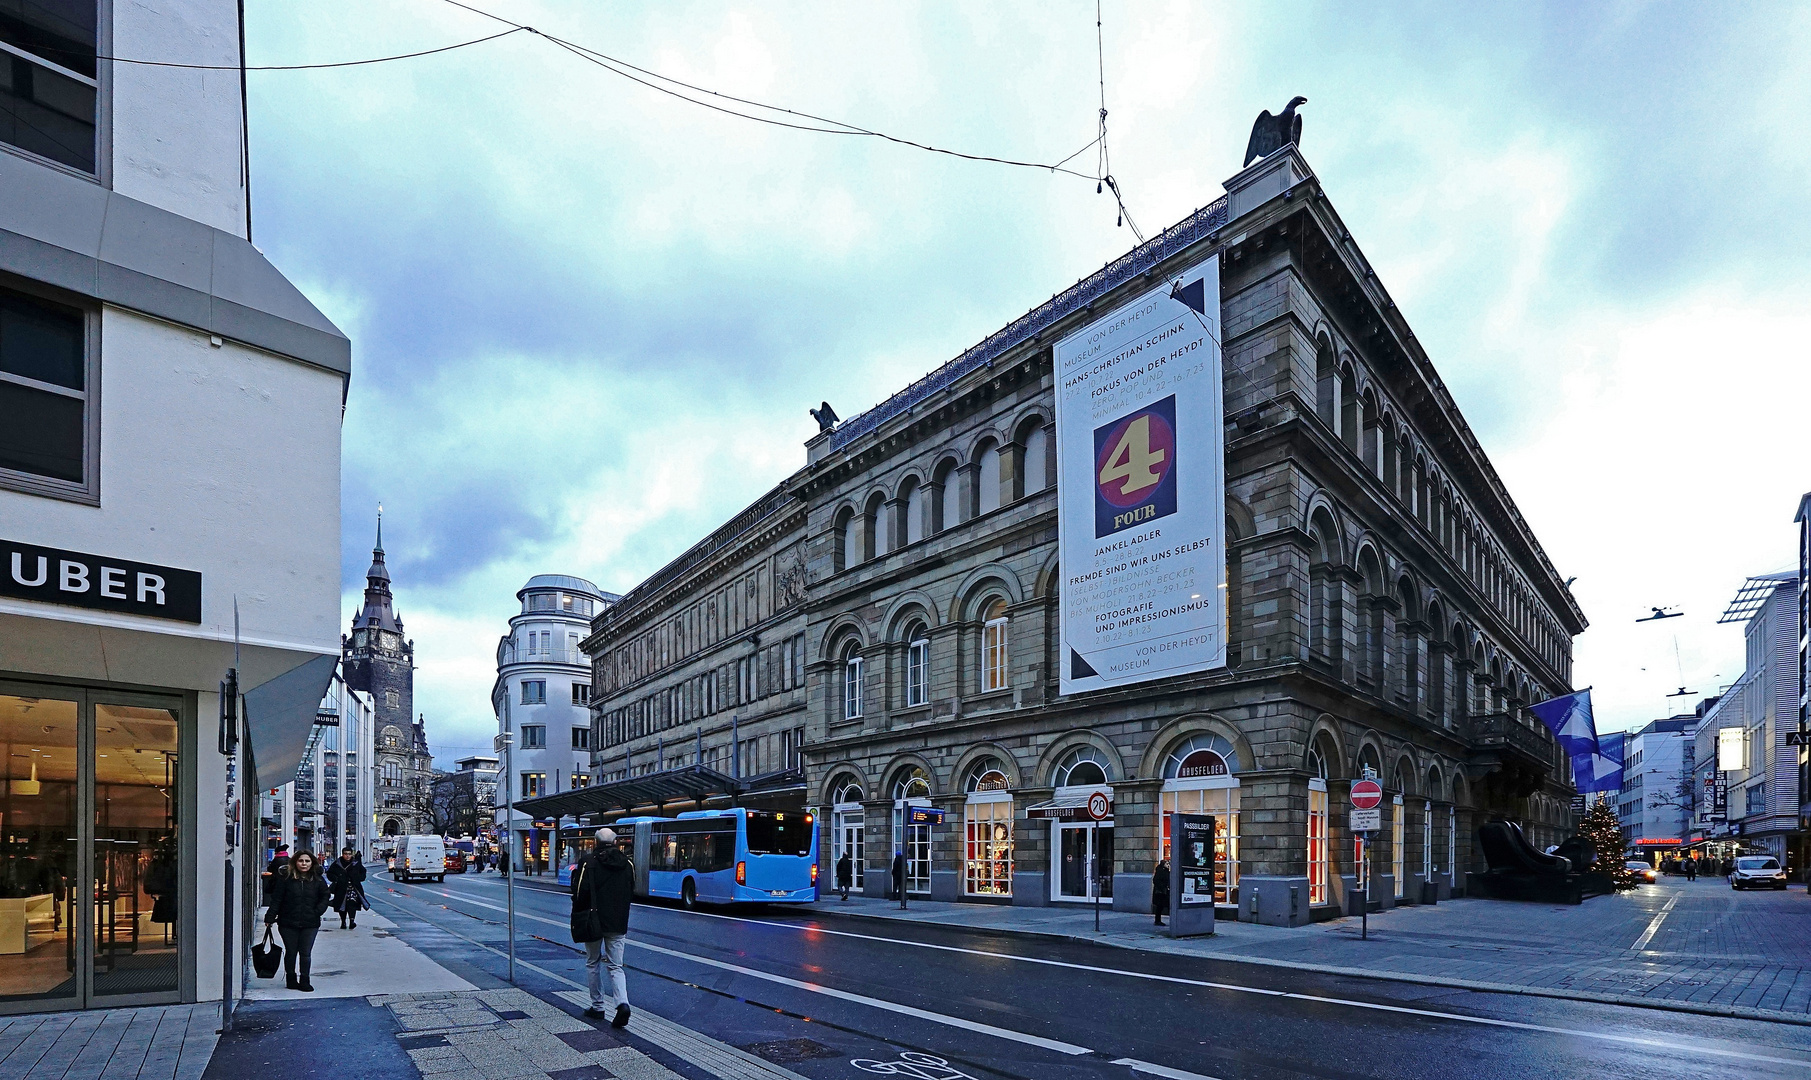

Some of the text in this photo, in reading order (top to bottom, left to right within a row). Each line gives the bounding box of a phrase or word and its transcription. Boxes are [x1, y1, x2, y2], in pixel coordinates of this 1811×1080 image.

[1087, 301, 1158, 344] VON DER HEYDT
[1064, 344, 1101, 369] MUSEUM
[1065, 322, 1185, 389] HANS-CHRISTIAN SCHINK
[1091, 337, 1204, 399] FOKUS VON DER HEYDT
[1120, 381, 1139, 394] POP
[1142, 369, 1164, 385] UND
[1092, 400, 1130, 420] MINIMAL
[1099, 414, 1165, 495] 4
[1113, 503, 1156, 529] FOUR
[1094, 529, 1161, 557] JANKEL ADLER
[1069, 537, 1211, 586] FREMDE SIND WIR UNS SELBST
[11, 552, 166, 605] UBER
[1070, 597, 1089, 607] VON
[1070, 609, 1083, 619] BIS
[1095, 601, 1153, 623] FOTOGRAFIE
[1095, 599, 1209, 634] UND IMPRESSIONISMUS
[1135, 633, 1213, 657] VON DER HEYDT
[1109, 658, 1150, 673] MUSEUM
[1182, 764, 1224, 776] HAUSFELDER
[1045, 808, 1074, 817] HAUSFELDER
[1093, 800, 1105, 812] 20
